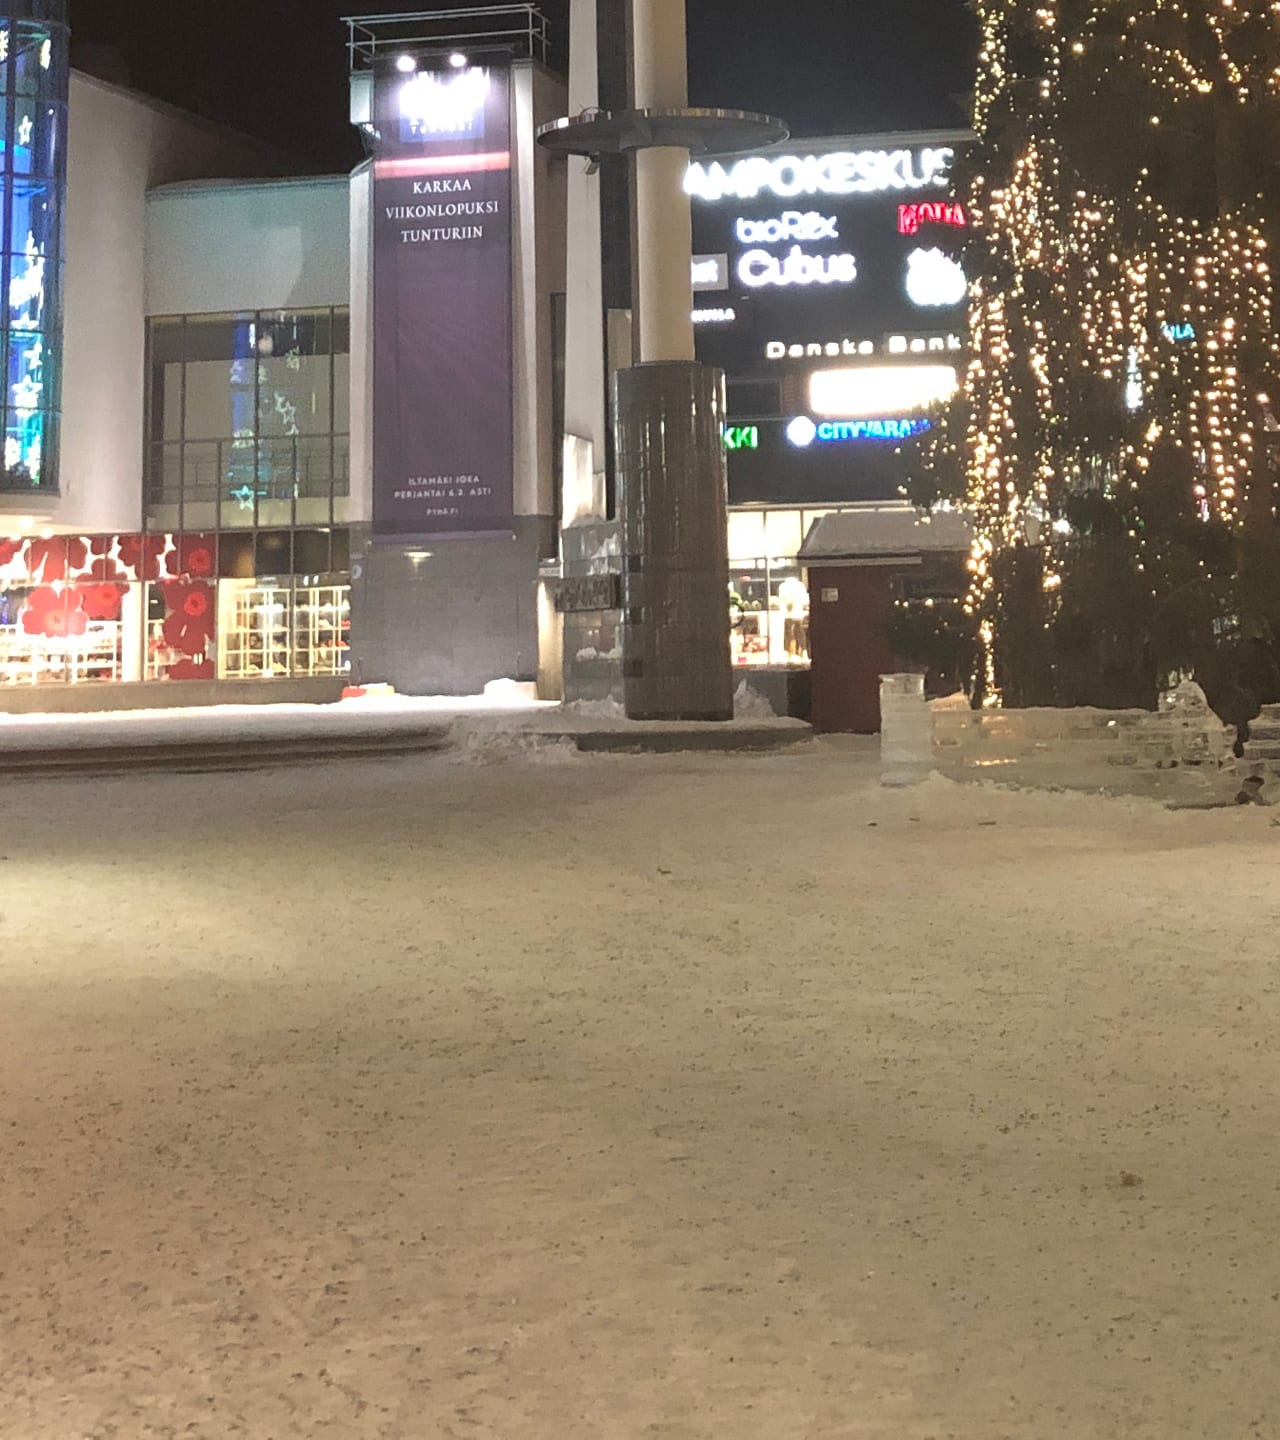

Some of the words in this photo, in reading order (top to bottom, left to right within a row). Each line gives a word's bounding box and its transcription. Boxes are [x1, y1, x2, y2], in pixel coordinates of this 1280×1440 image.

[412, 178, 472, 195] KARKAA
[385, 200, 499, 220] VIIKONLOPUKSI
[400, 225, 484, 243] TUNTURIIN
[766, 337, 874, 359] Danske
[888, 332, 962, 353] Bank
